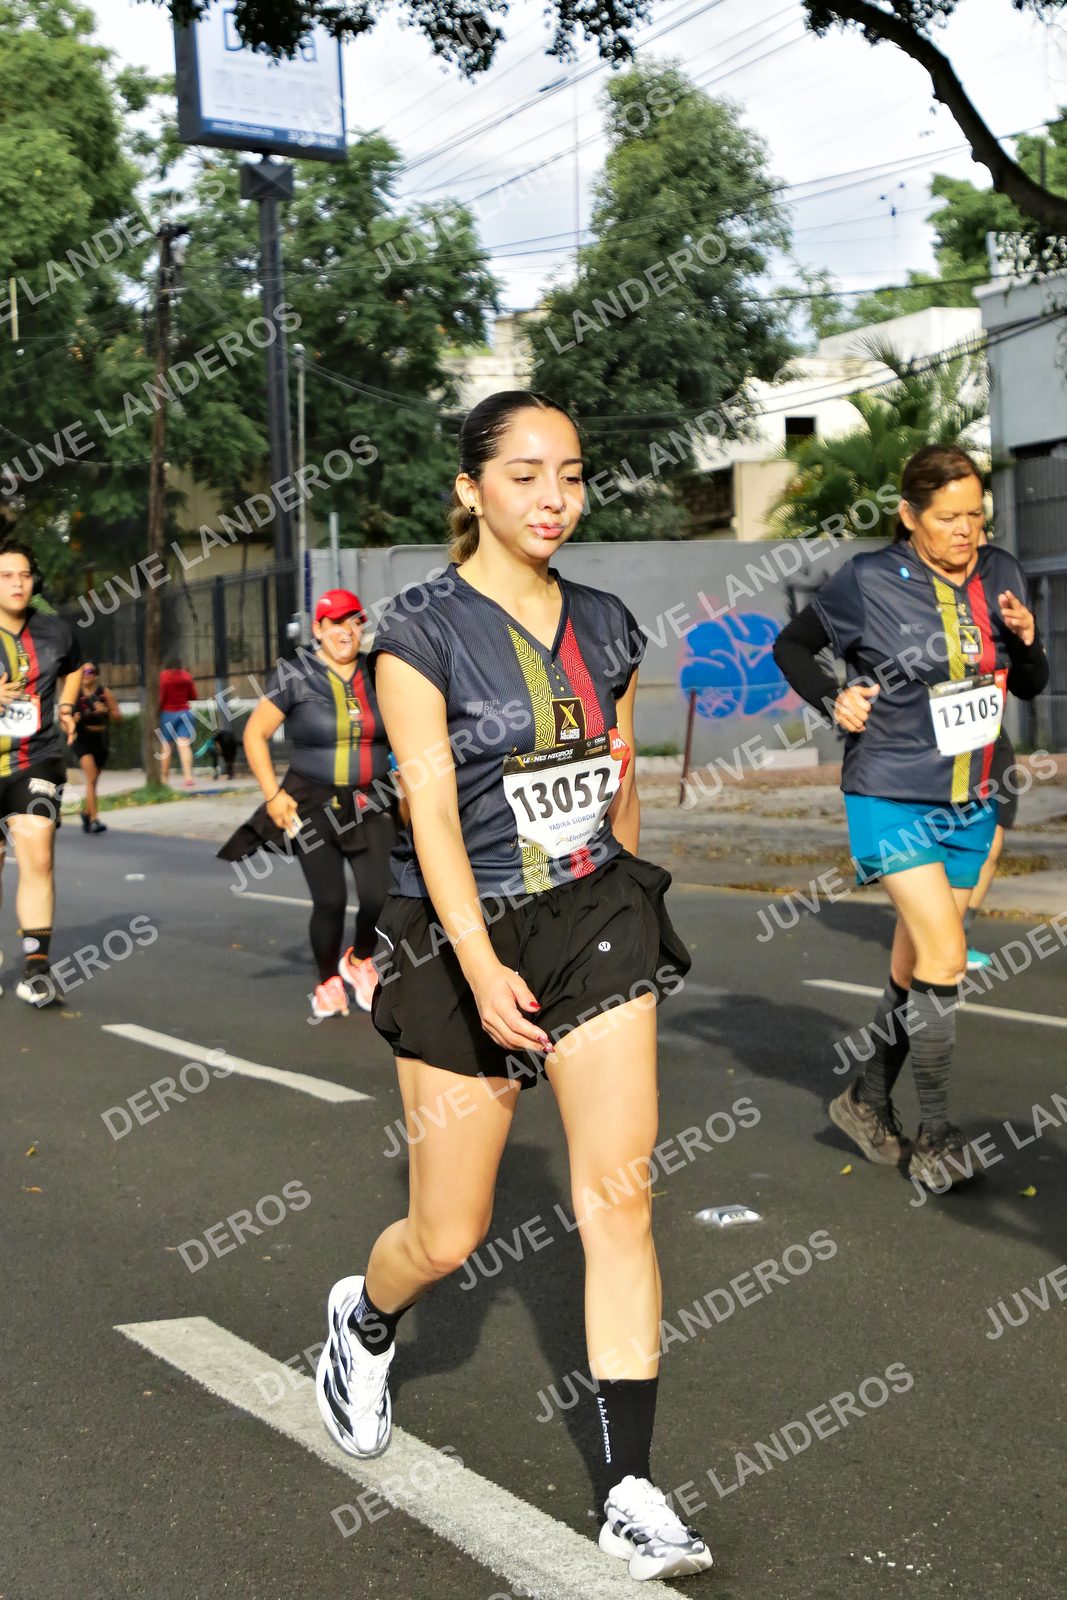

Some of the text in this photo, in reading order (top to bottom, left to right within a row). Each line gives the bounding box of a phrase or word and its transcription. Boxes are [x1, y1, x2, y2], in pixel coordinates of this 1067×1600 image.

[938, 694, 999, 728] 12105
[512, 768, 613, 823] 13052
[549, 821, 571, 831] YADIRA
[597, 1397, 611, 1463] lululemon
